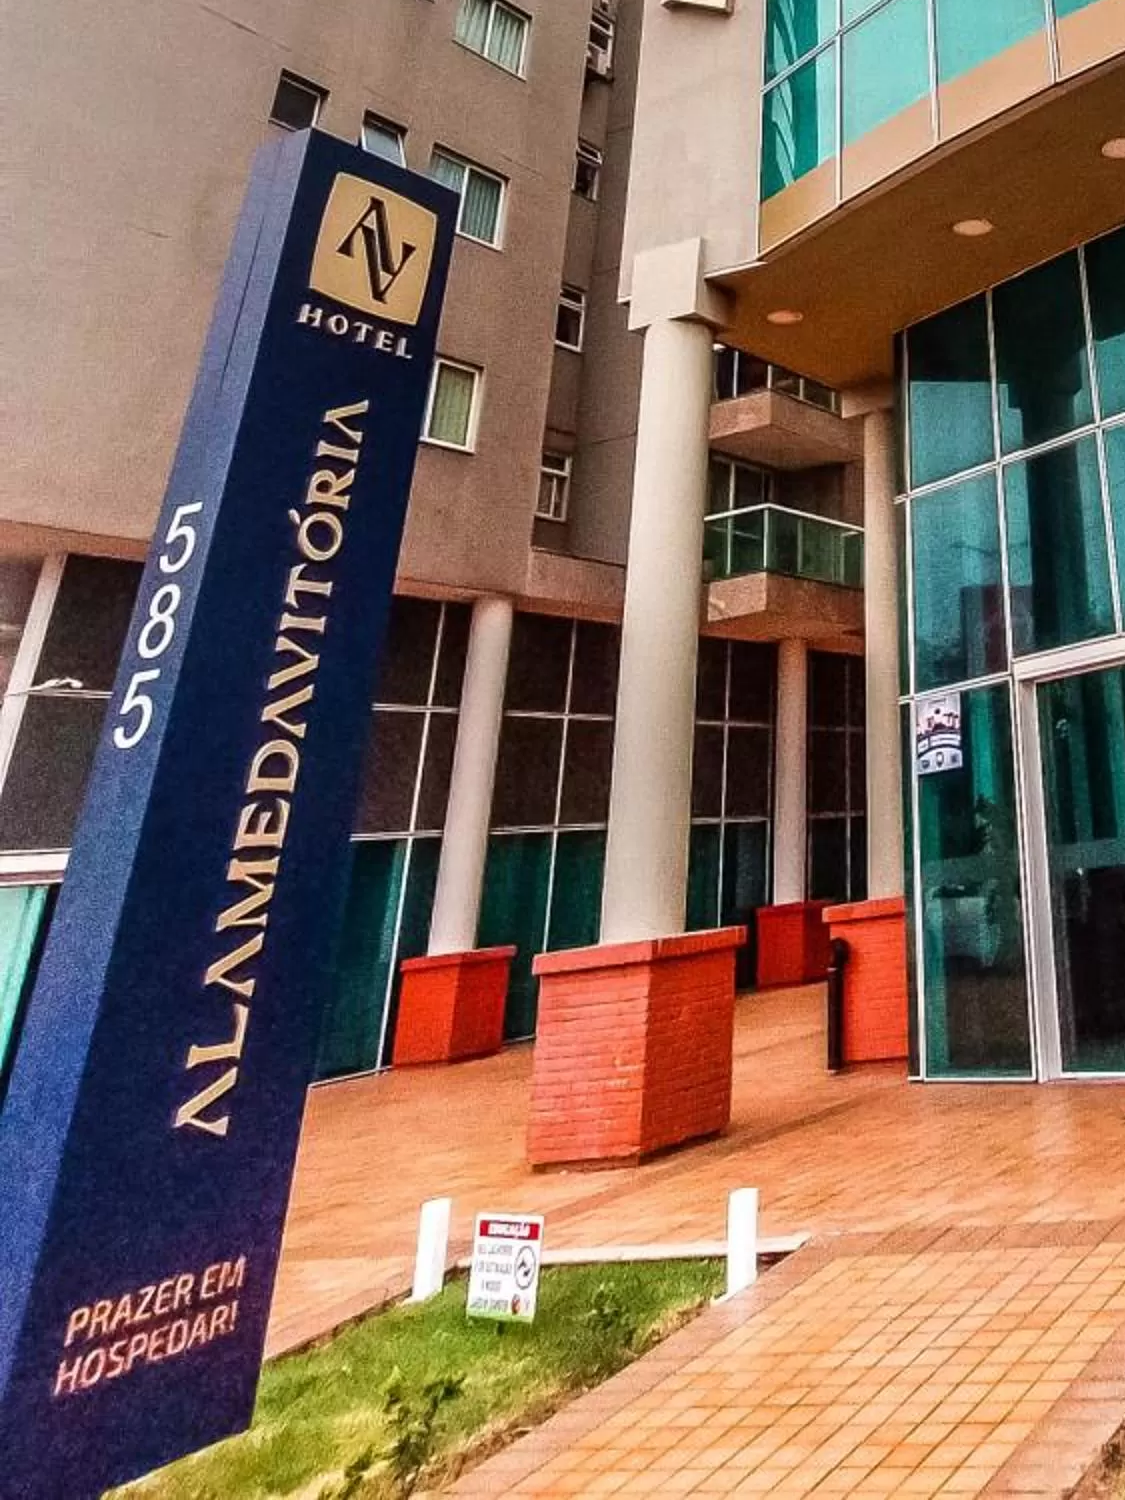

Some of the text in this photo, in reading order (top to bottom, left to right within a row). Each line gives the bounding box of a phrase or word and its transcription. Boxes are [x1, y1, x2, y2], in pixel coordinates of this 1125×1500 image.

[296, 303, 413, 359] HOTEL
[112, 500, 204, 750] 585
[64, 1253, 247, 1347] PRAZER EM
[54, 1300, 239, 1397] HOSPEDAR!
